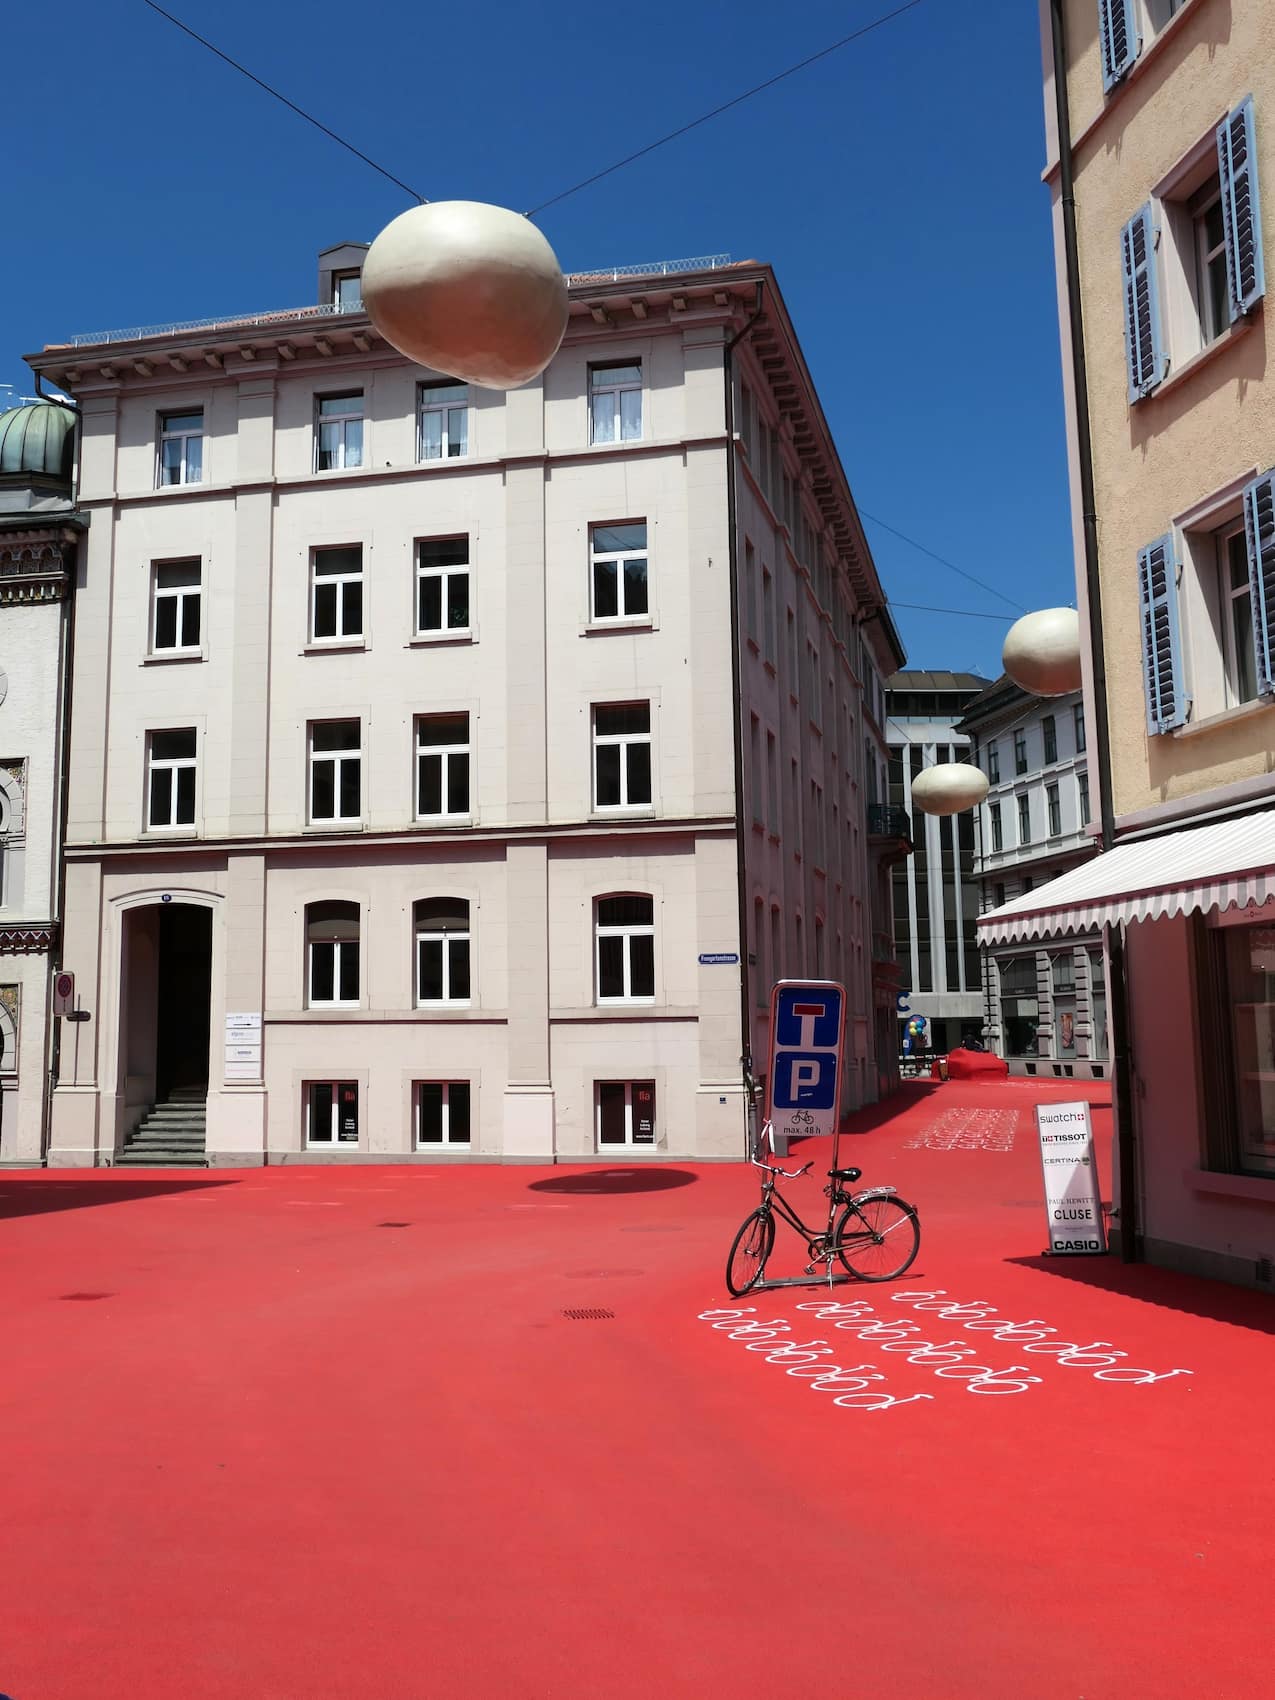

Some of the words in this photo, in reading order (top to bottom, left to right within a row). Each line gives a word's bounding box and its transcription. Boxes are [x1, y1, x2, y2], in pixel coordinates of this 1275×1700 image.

[790, 1060, 820, 1101] P
[1040, 1112, 1077, 1124] swatch
[805, 1126, 814, 1134] 48
[815, 1126, 821, 1134] h
[1053, 1133, 1087, 1142] TISSOT
[1054, 1209, 1092, 1220] CLUSE
[1054, 1240, 1099, 1250] CASIO
